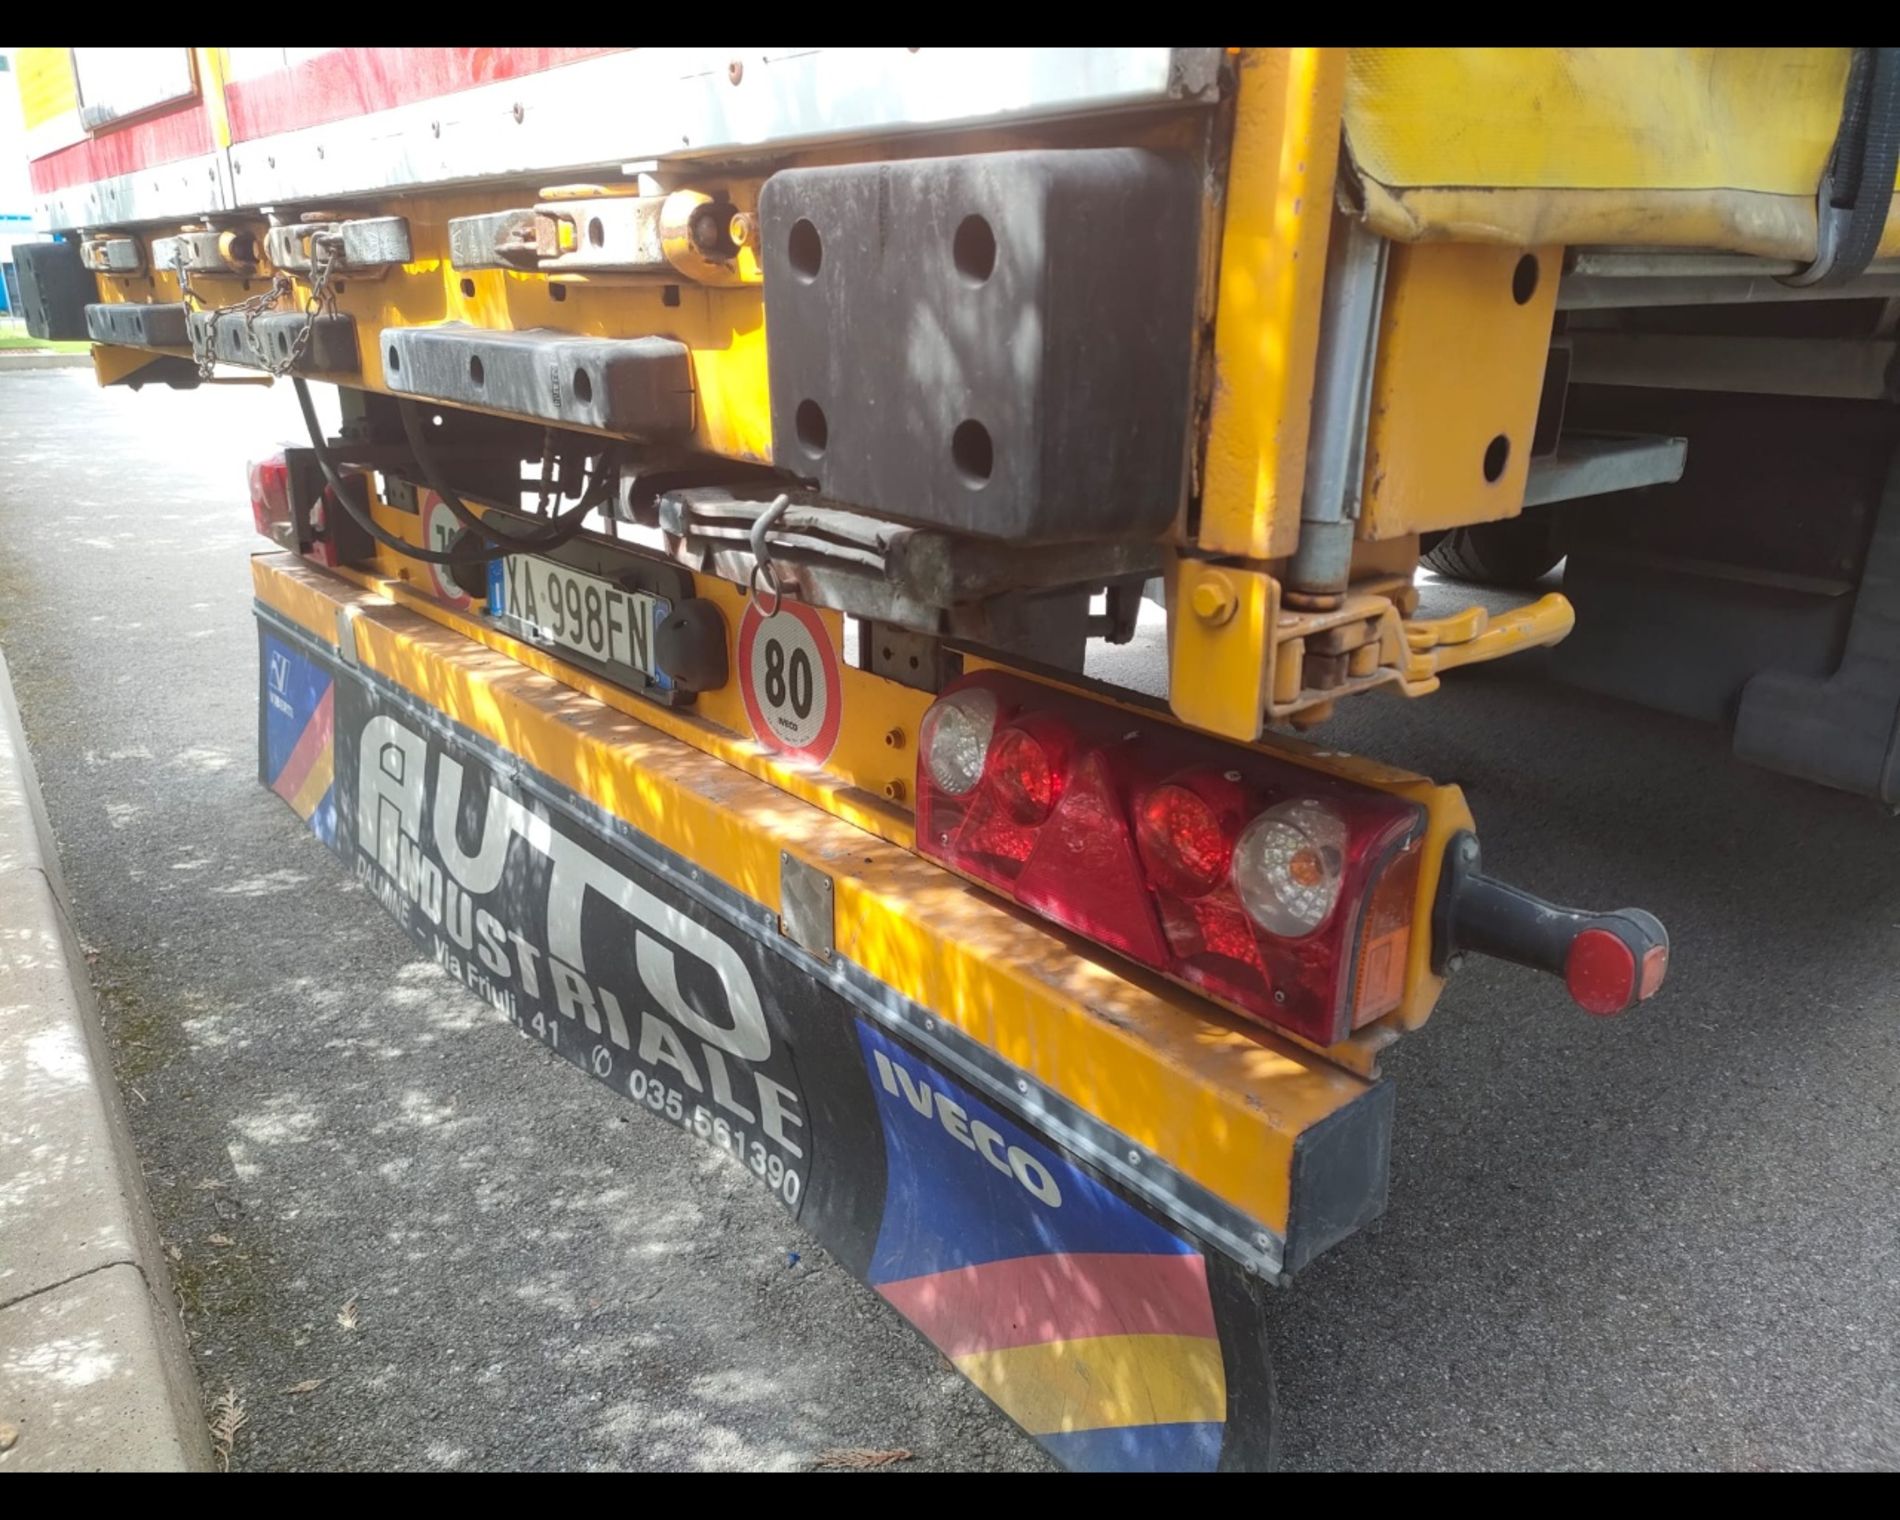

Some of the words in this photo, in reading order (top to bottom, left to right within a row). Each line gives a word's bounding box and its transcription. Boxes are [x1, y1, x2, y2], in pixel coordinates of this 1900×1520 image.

[764, 638, 813, 720] 80
[778, 716, 799, 732] IVECO
[357, 853, 410, 929] DALMINE
[434, 934, 462, 980] Via
[531, 1011, 559, 1048] 41
[358, 714, 771, 1062] AUTO
[378, 800, 804, 1160] INDUSTRIALE
[873, 1049, 1062, 1208] IVECO
